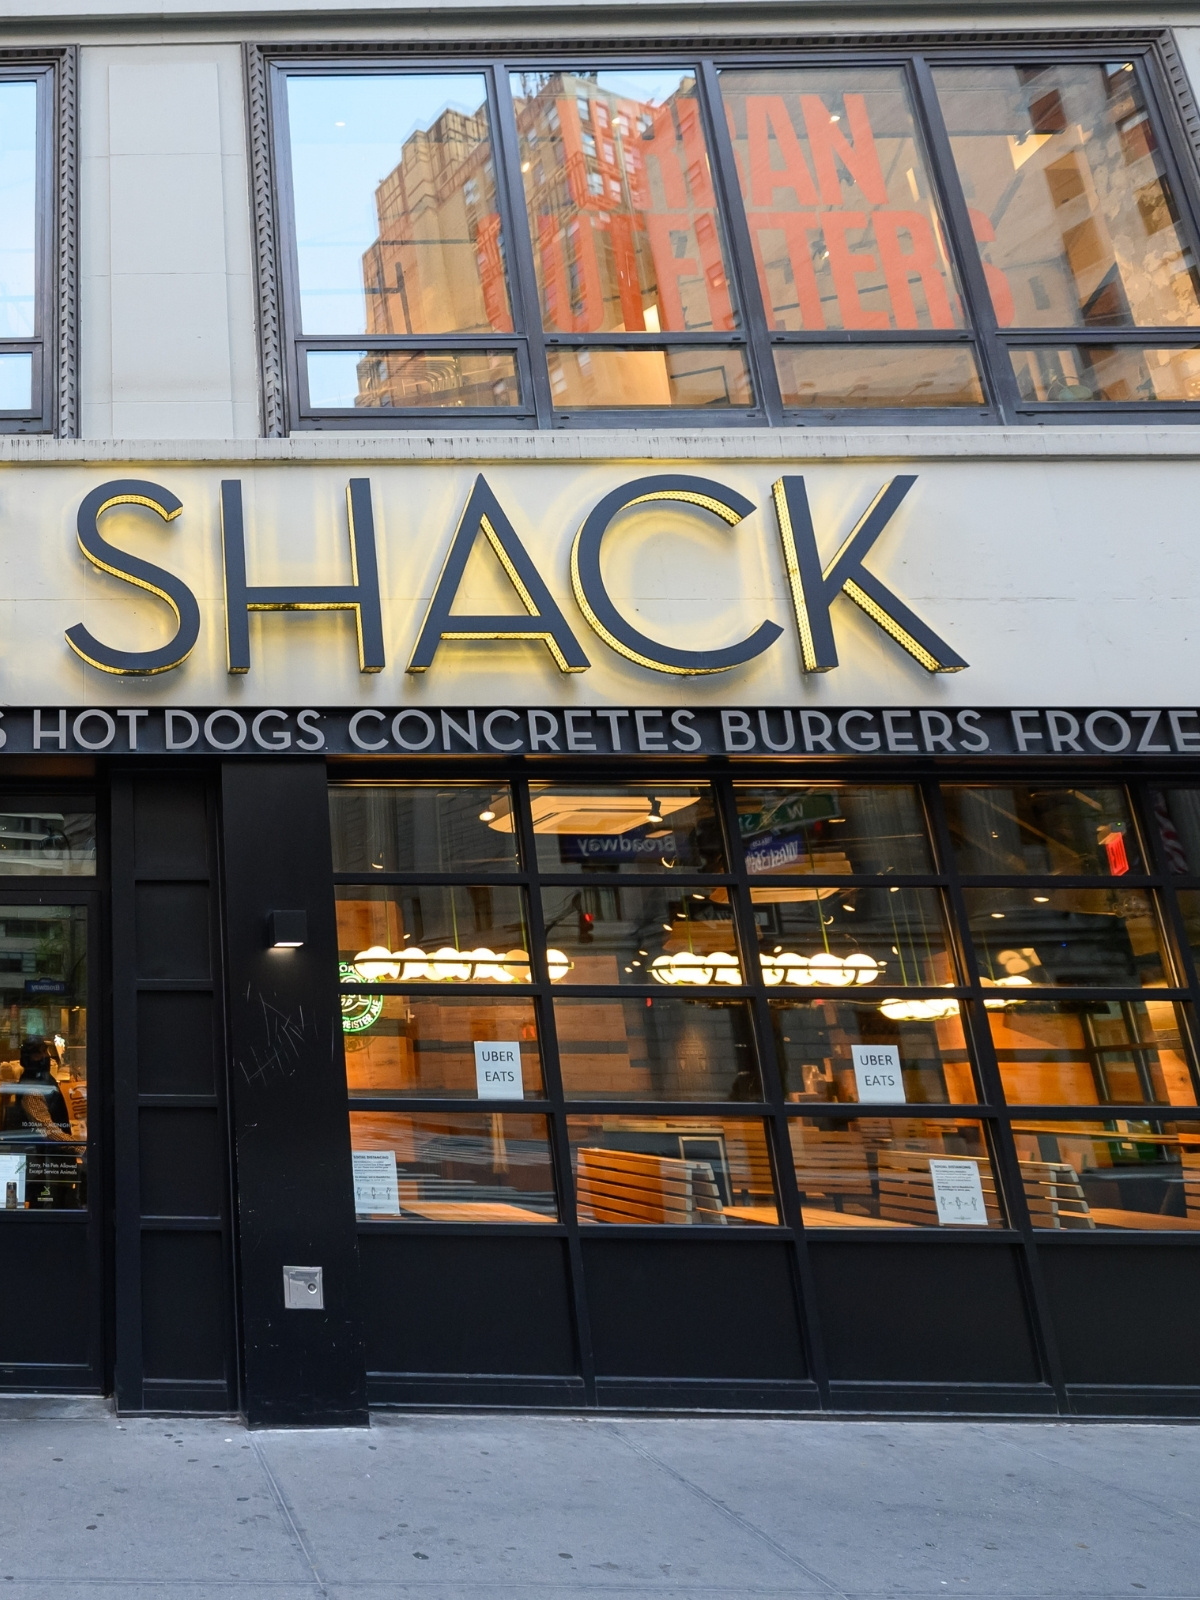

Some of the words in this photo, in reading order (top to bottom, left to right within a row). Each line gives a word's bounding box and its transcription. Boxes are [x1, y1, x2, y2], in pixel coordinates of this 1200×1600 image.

[64, 472, 970, 677] SHACK
[32, 708, 149, 751] HOT
[164, 709, 326, 751] DOGS
[348, 708, 703, 752] CONCRETES
[720, 709, 990, 753] BURGERS
[481, 1051, 515, 1062] UBER
[860, 1054, 894, 1066] UBER
[485, 1071, 515, 1082] EATS
[864, 1075, 895, 1086] EATS
